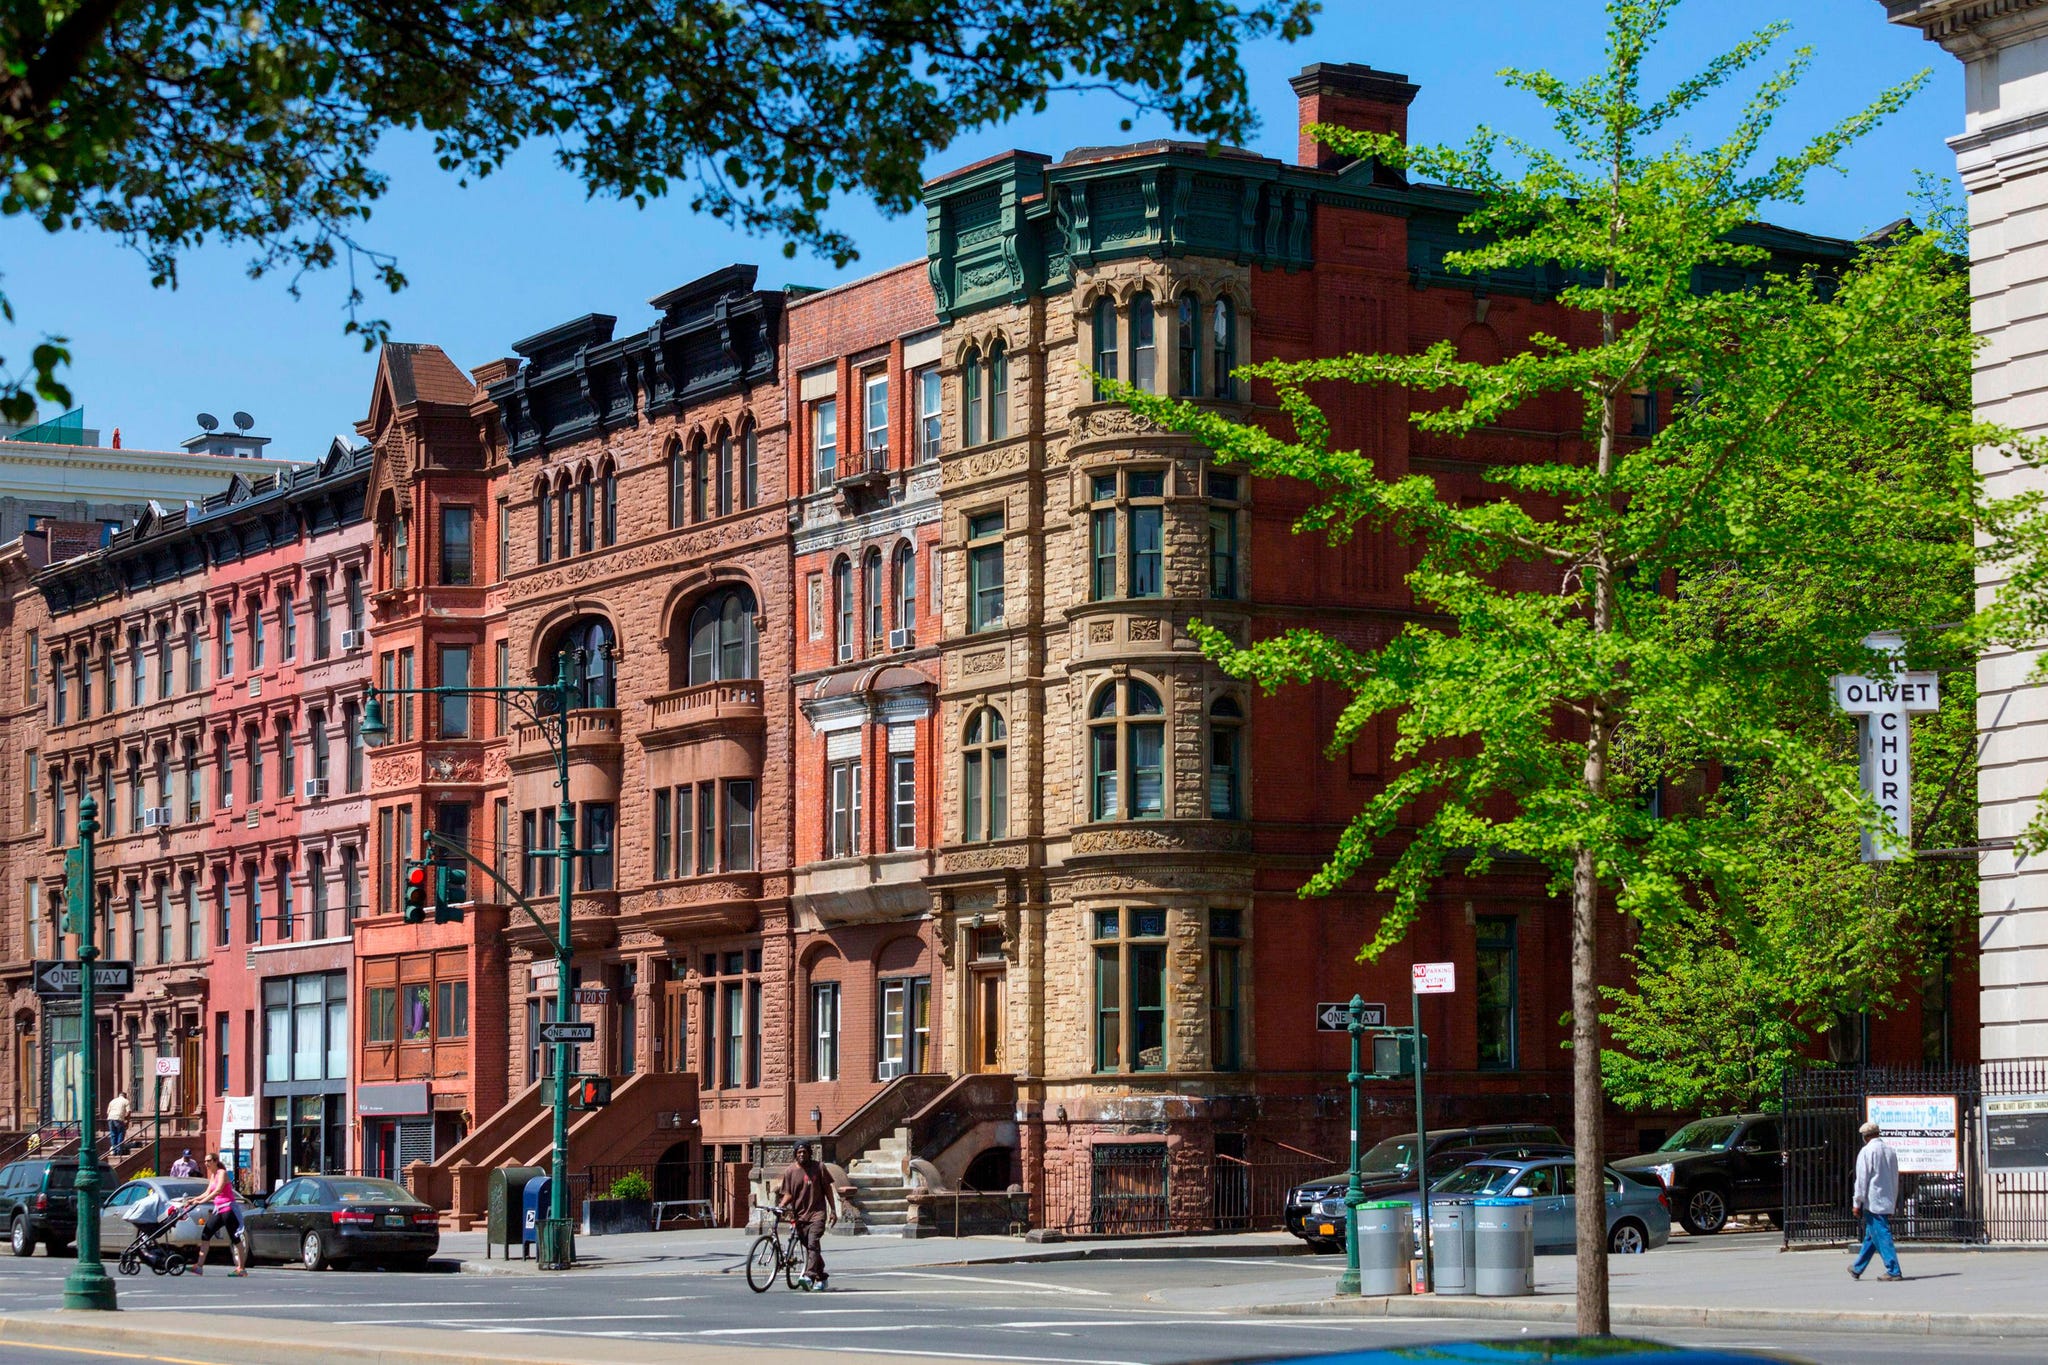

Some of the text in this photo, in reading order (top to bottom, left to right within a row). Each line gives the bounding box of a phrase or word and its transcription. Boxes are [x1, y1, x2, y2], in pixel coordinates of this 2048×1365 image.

[1847, 684, 1931, 703] OLIVET
[1881, 712, 1899, 834] CHURC
[51, 970, 79, 984] ONE
[1414, 966, 1426, 977] NO
[574, 991, 608, 1004] W 120 ST
[1327, 1012, 1346, 1023] ONE
[547, 1028, 588, 1038] ONE WAY
[1870, 1105, 1954, 1127] Community Meal
